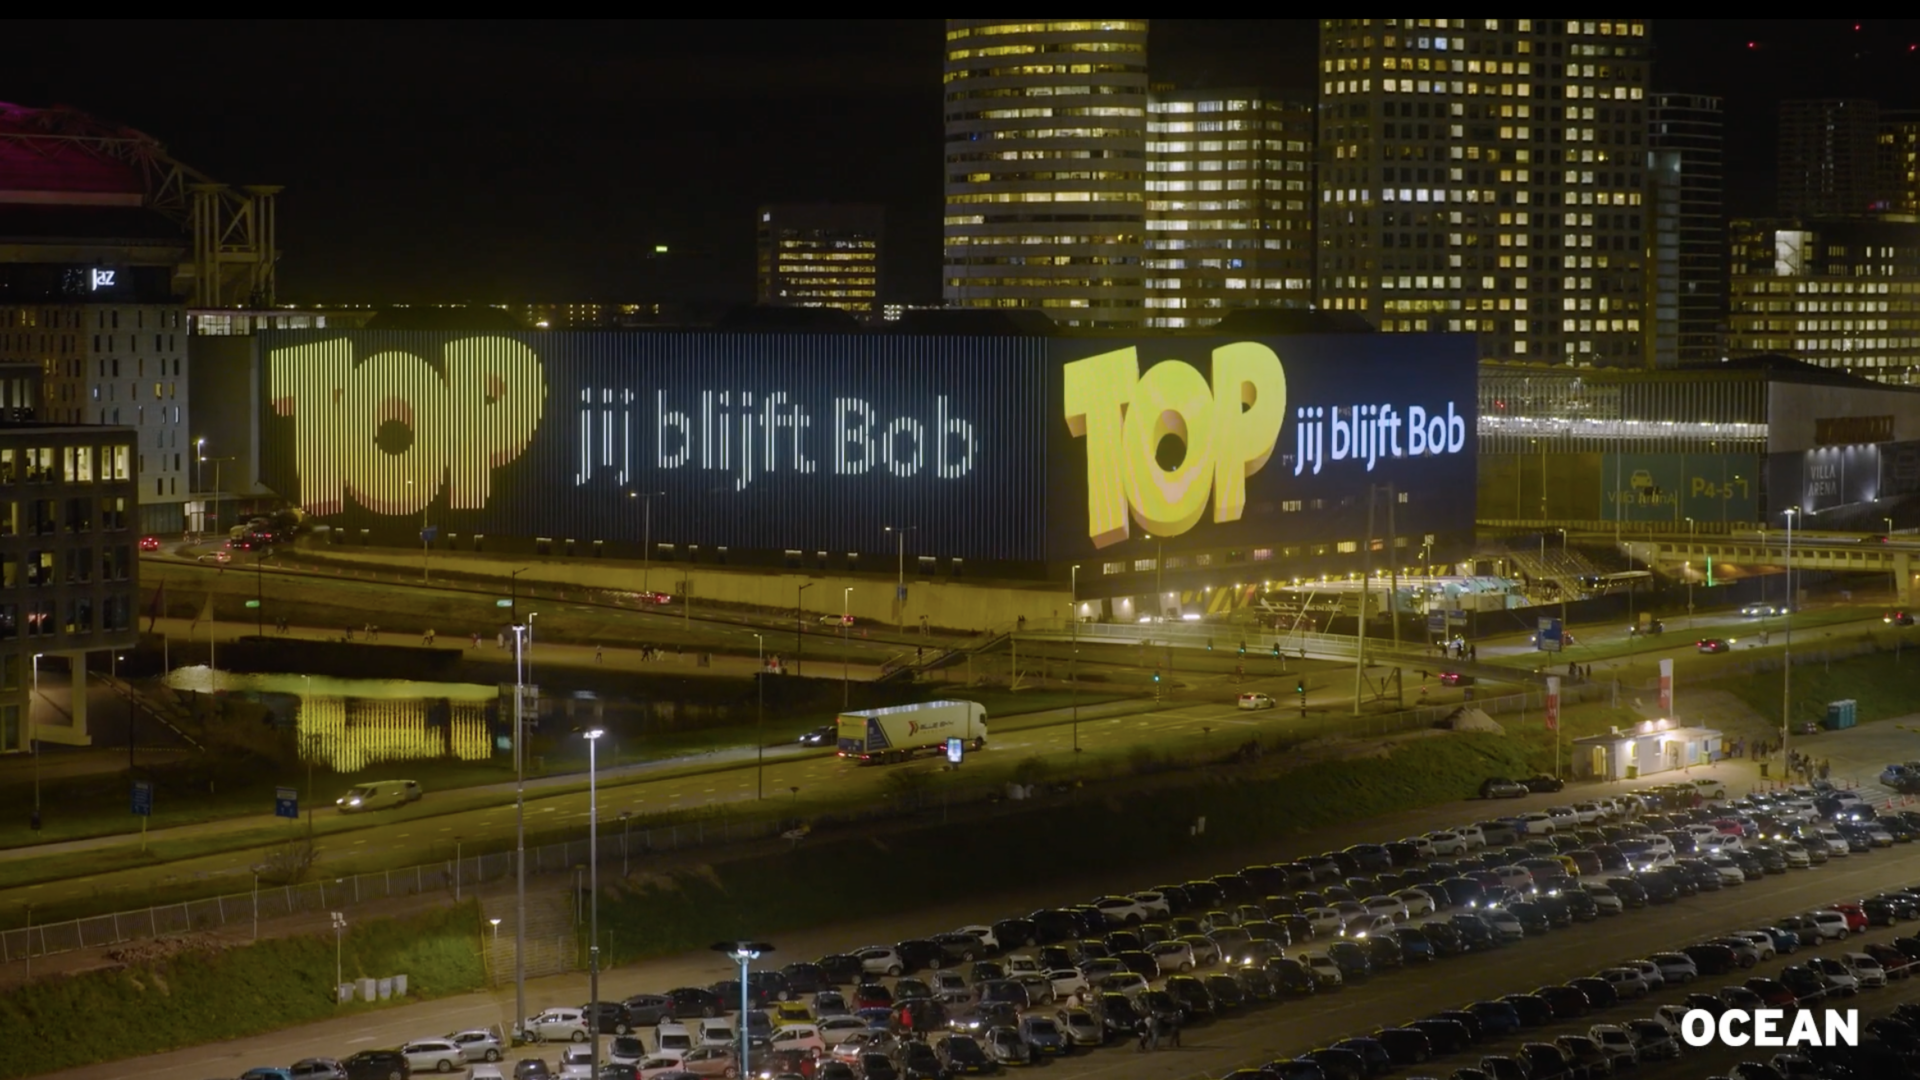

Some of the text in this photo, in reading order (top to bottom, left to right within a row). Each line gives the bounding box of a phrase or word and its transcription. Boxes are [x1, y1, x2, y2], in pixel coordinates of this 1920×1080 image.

[92, 268, 115, 291] Jaz
[271, 336, 977, 517] TOP jij blijft Bob
[1064, 341, 1465, 549] TOP jij blijft Bob
[1810, 464, 1836, 479] VILLA
[1808, 481, 1837, 497] ARENA
